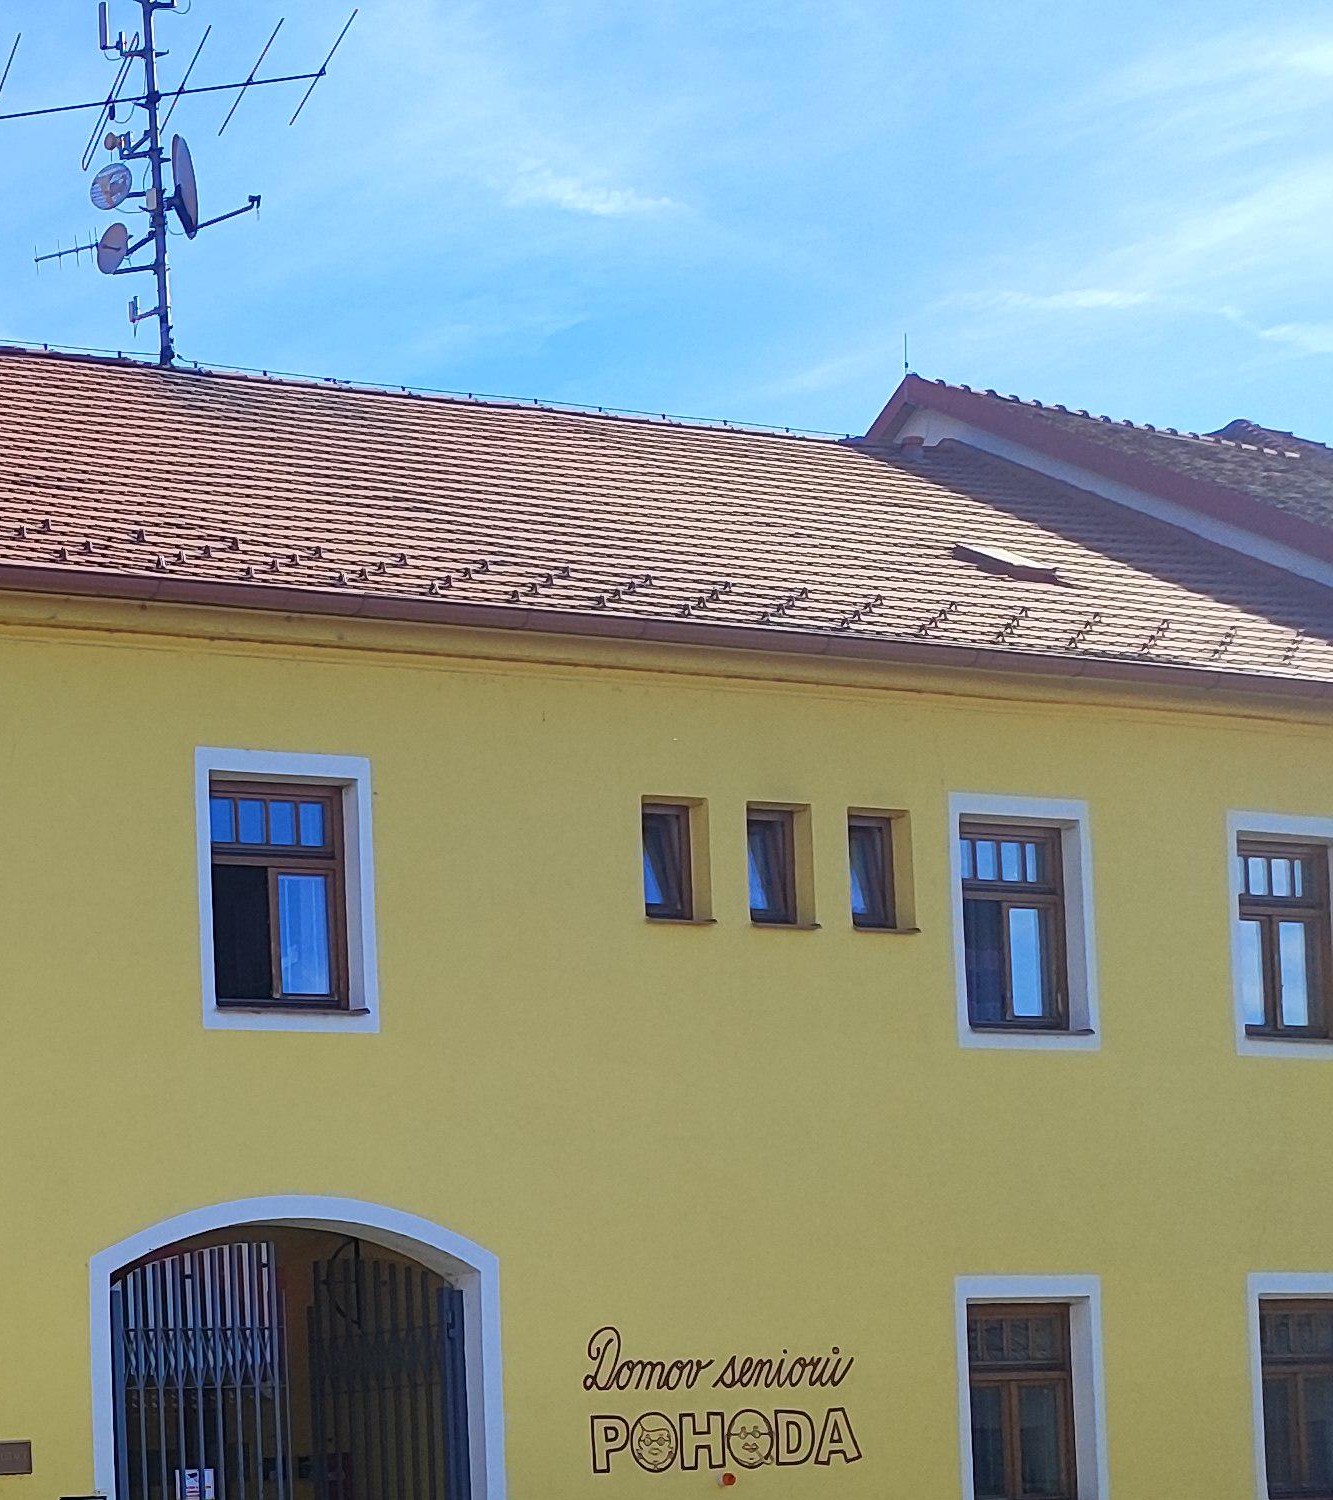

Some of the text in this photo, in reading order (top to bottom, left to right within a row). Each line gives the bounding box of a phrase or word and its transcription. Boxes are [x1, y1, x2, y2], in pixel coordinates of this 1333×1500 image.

[583, 1326, 854, 1391] Domov seniorů
[590, 1407, 863, 1473] POHODA
